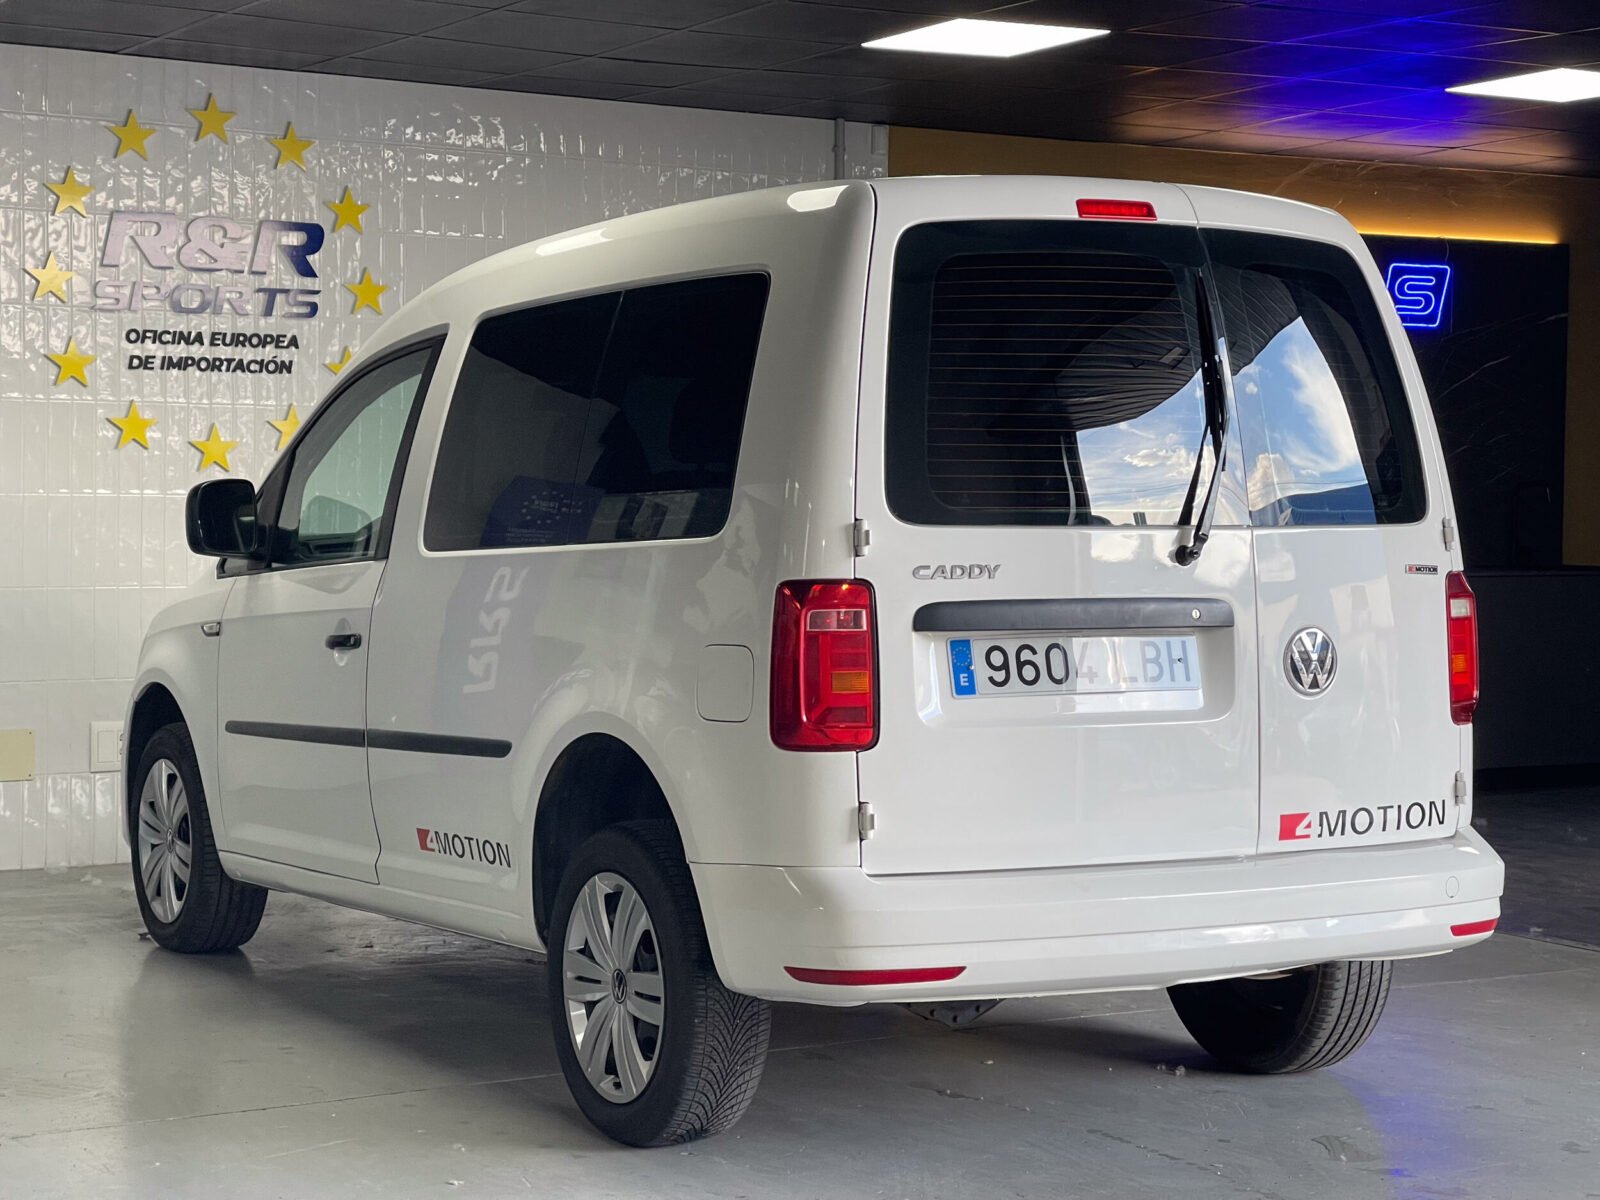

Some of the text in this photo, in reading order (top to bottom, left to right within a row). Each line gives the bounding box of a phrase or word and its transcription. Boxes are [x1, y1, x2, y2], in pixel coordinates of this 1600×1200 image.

[101, 210, 325, 278] R&R
[92, 278, 322, 319] SPORTS
[124, 328, 300, 350] OFICINA EUROPEA
[127, 355, 294, 375] DE IMPORTACIÓN
[912, 564, 1001, 580] CADDY
[959, 673, 969, 686] E
[984, 641, 1099, 689] 9604
[1278, 798, 1447, 841] 4MOTION
[416, 827, 511, 869] 4MOTION
